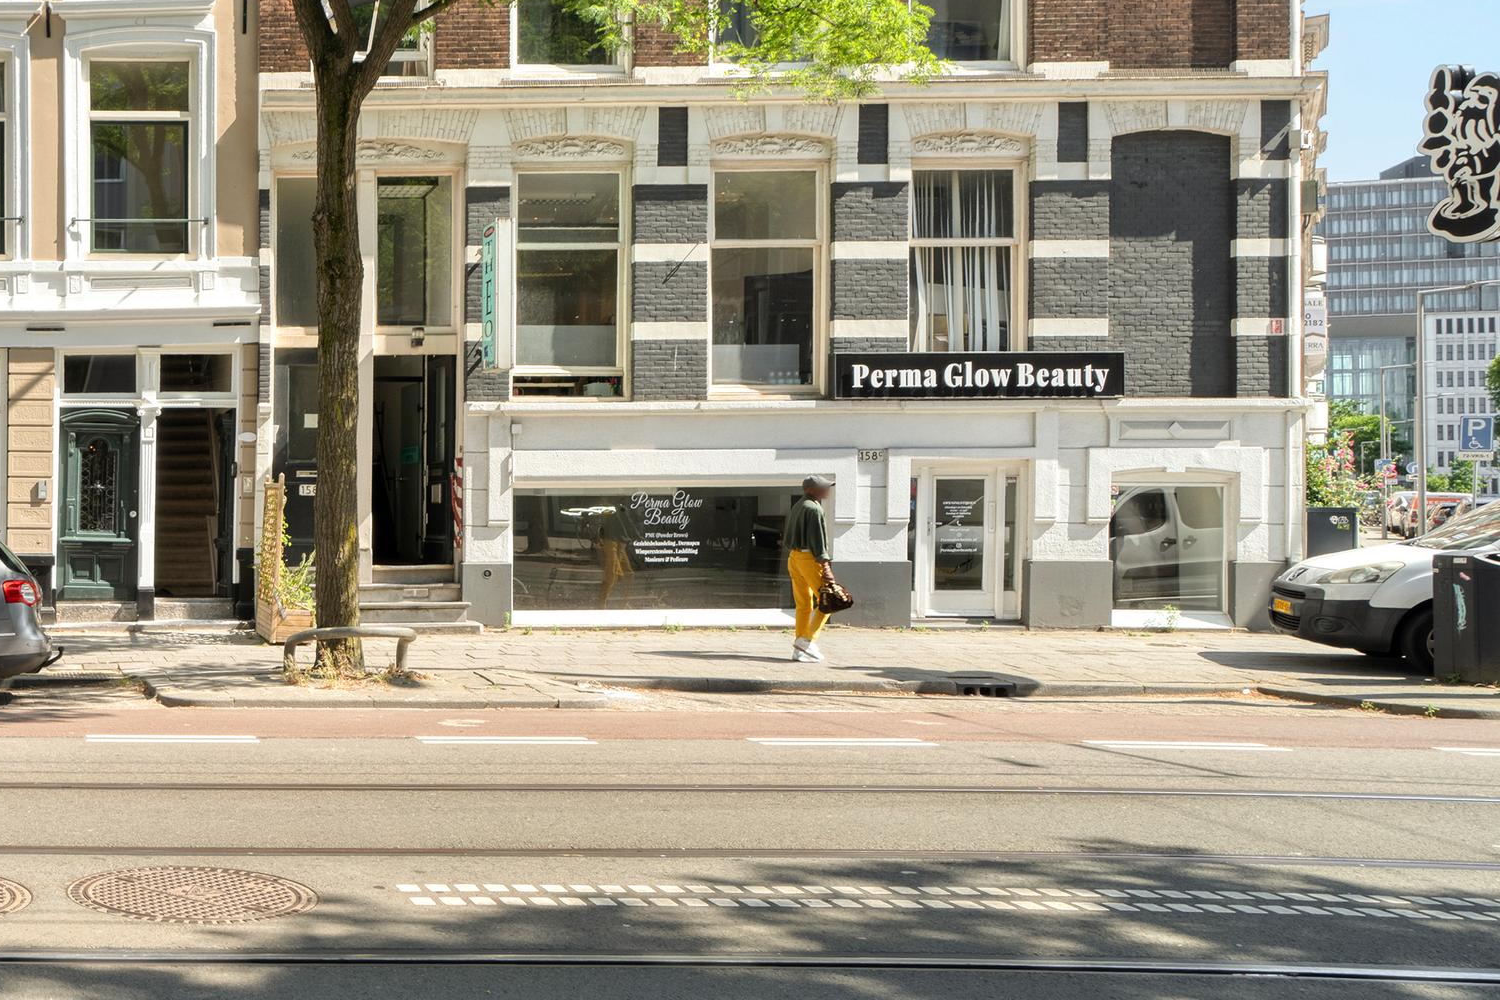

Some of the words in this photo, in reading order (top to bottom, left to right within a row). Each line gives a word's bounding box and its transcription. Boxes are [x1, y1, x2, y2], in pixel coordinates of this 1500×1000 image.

[851, 364, 938, 388] Perma
[943, 361, 1012, 388] Glow
[1016, 363, 1109, 392] Beauty
[1468, 418, 1486, 436] P
[630, 491, 670, 509] Perma
[671, 490, 703, 515] Glow
[644, 507, 690, 530] Beauty
